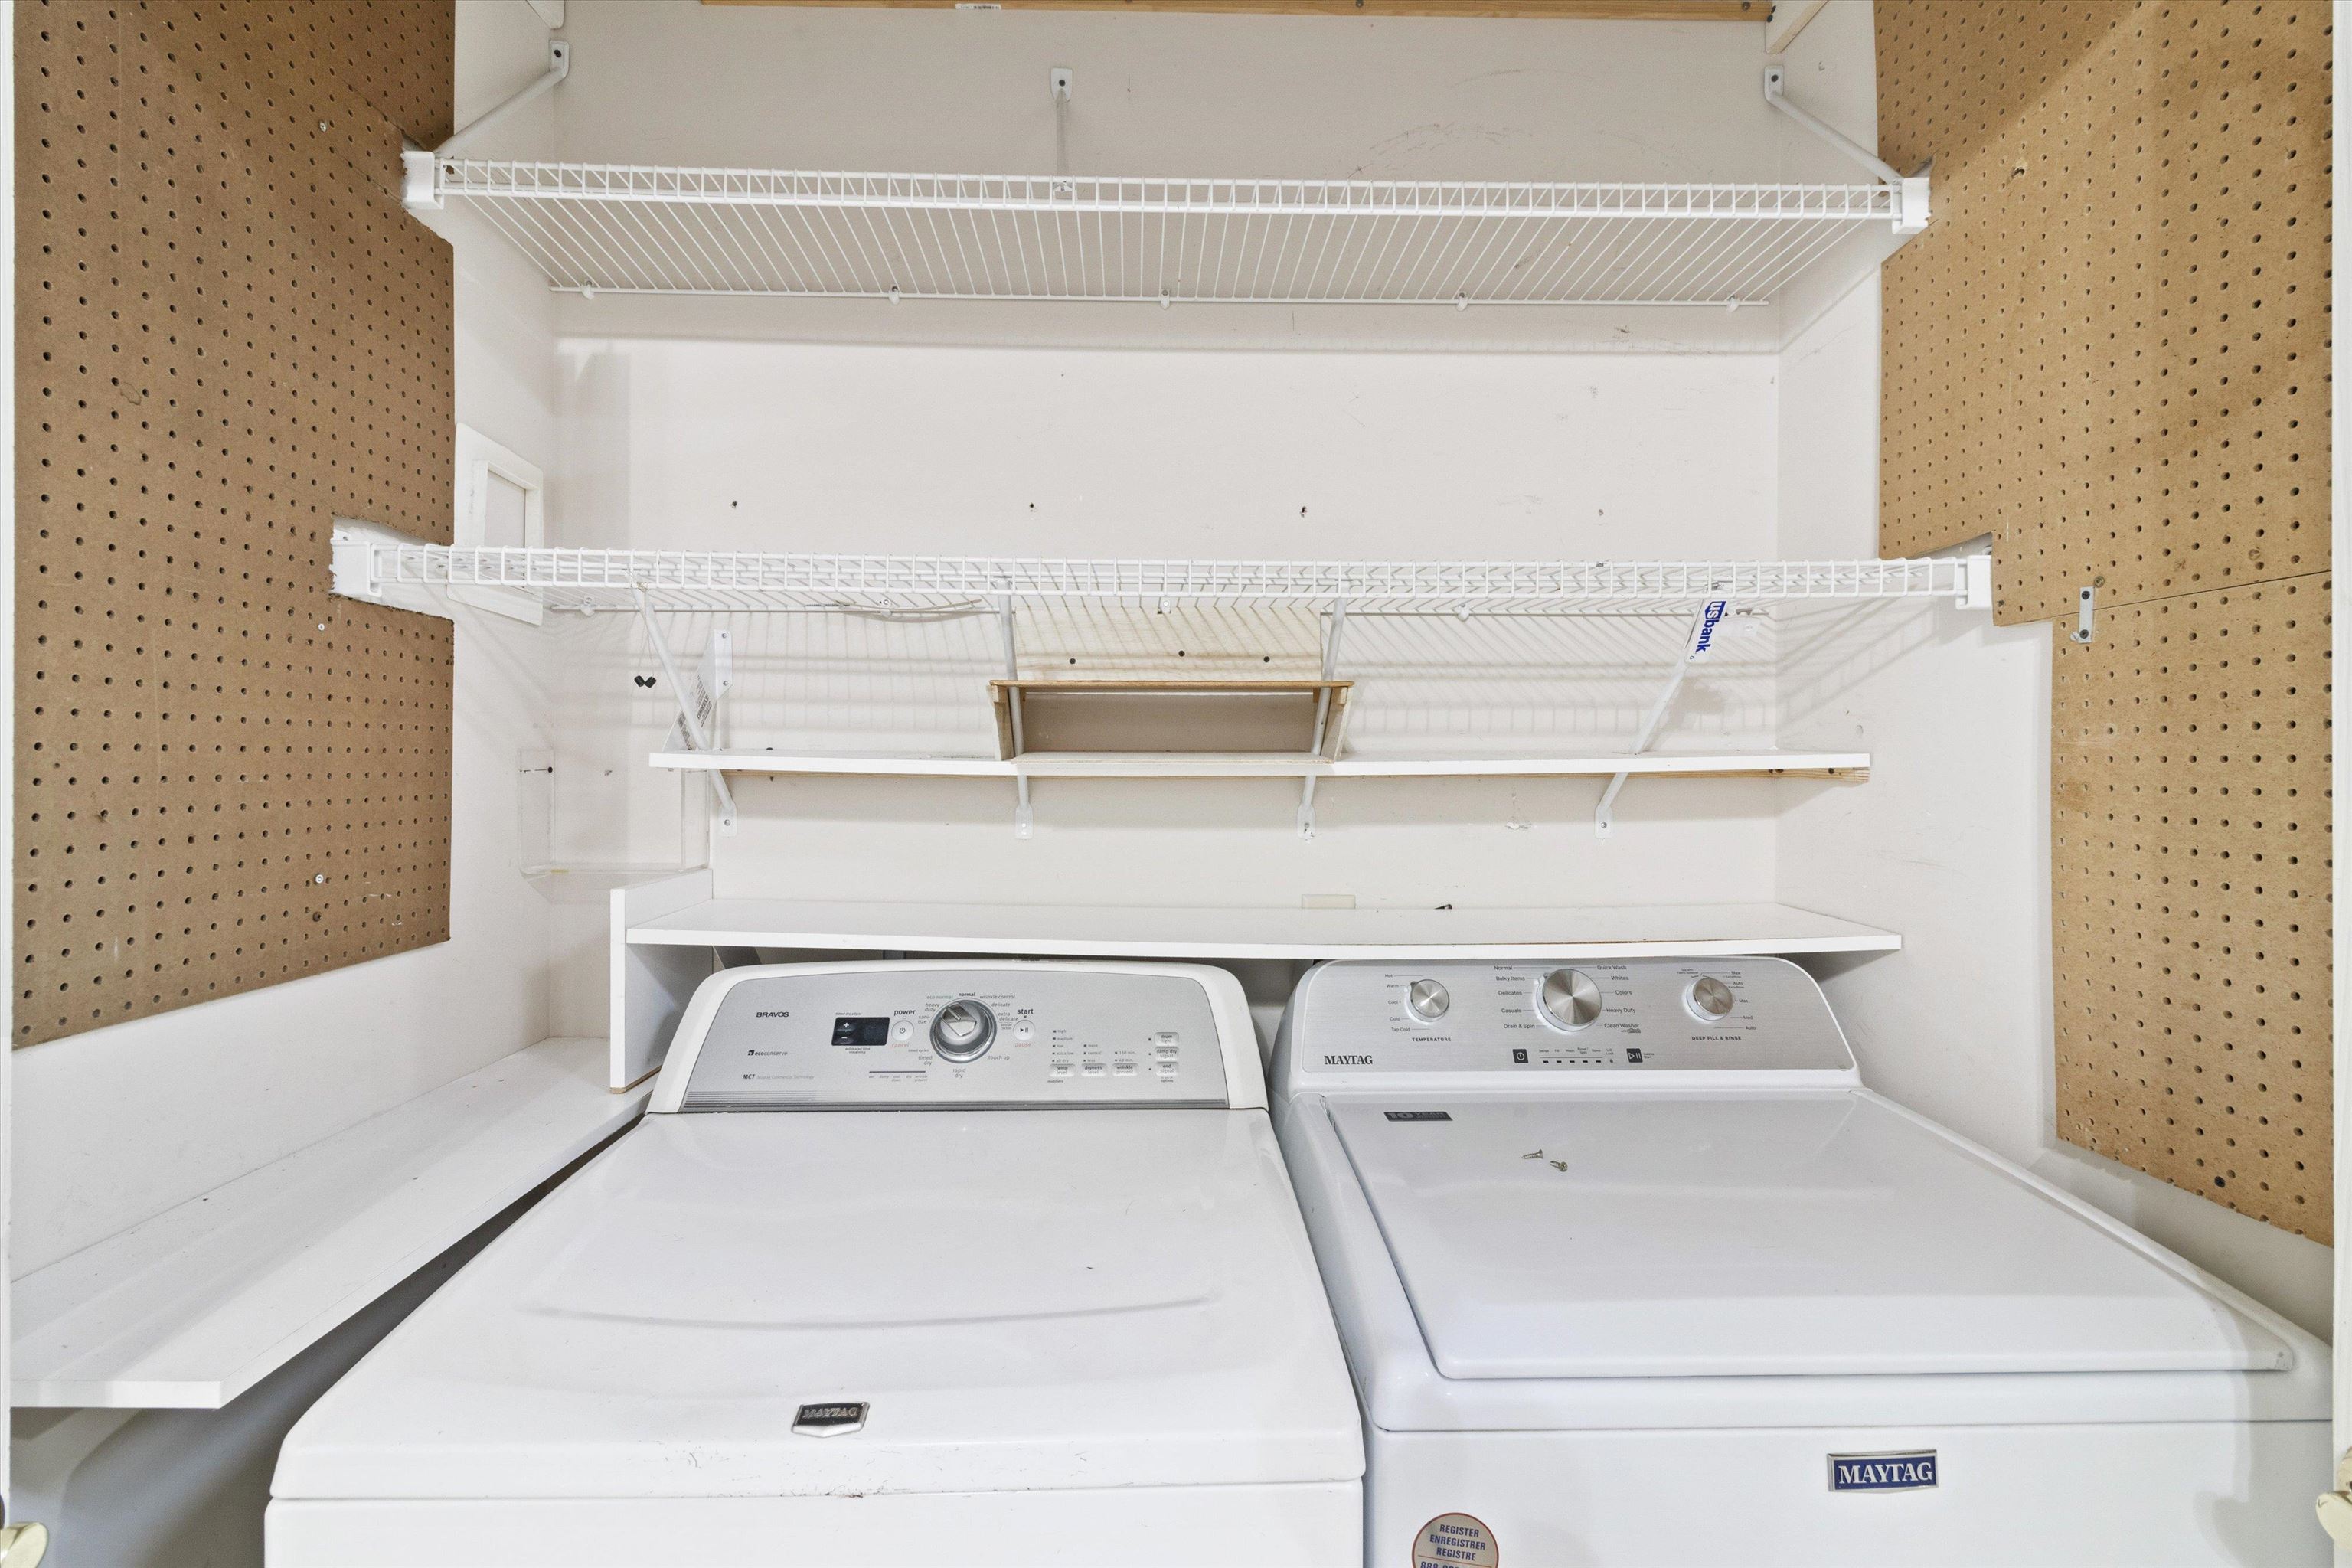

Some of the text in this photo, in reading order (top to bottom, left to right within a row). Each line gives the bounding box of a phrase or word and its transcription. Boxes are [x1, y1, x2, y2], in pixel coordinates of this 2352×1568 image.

[1325, 1055, 1373, 1065] MAYTAG
[802, 1407, 858, 1419] MAYTAG
[1838, 1462, 1932, 1484] MAYTAG
[1440, 1524, 1479, 1537] REGISTER
[1430, 1534, 1485, 1550] ENREGISTRER
[1436, 1547, 1476, 1561] REGISTRE
